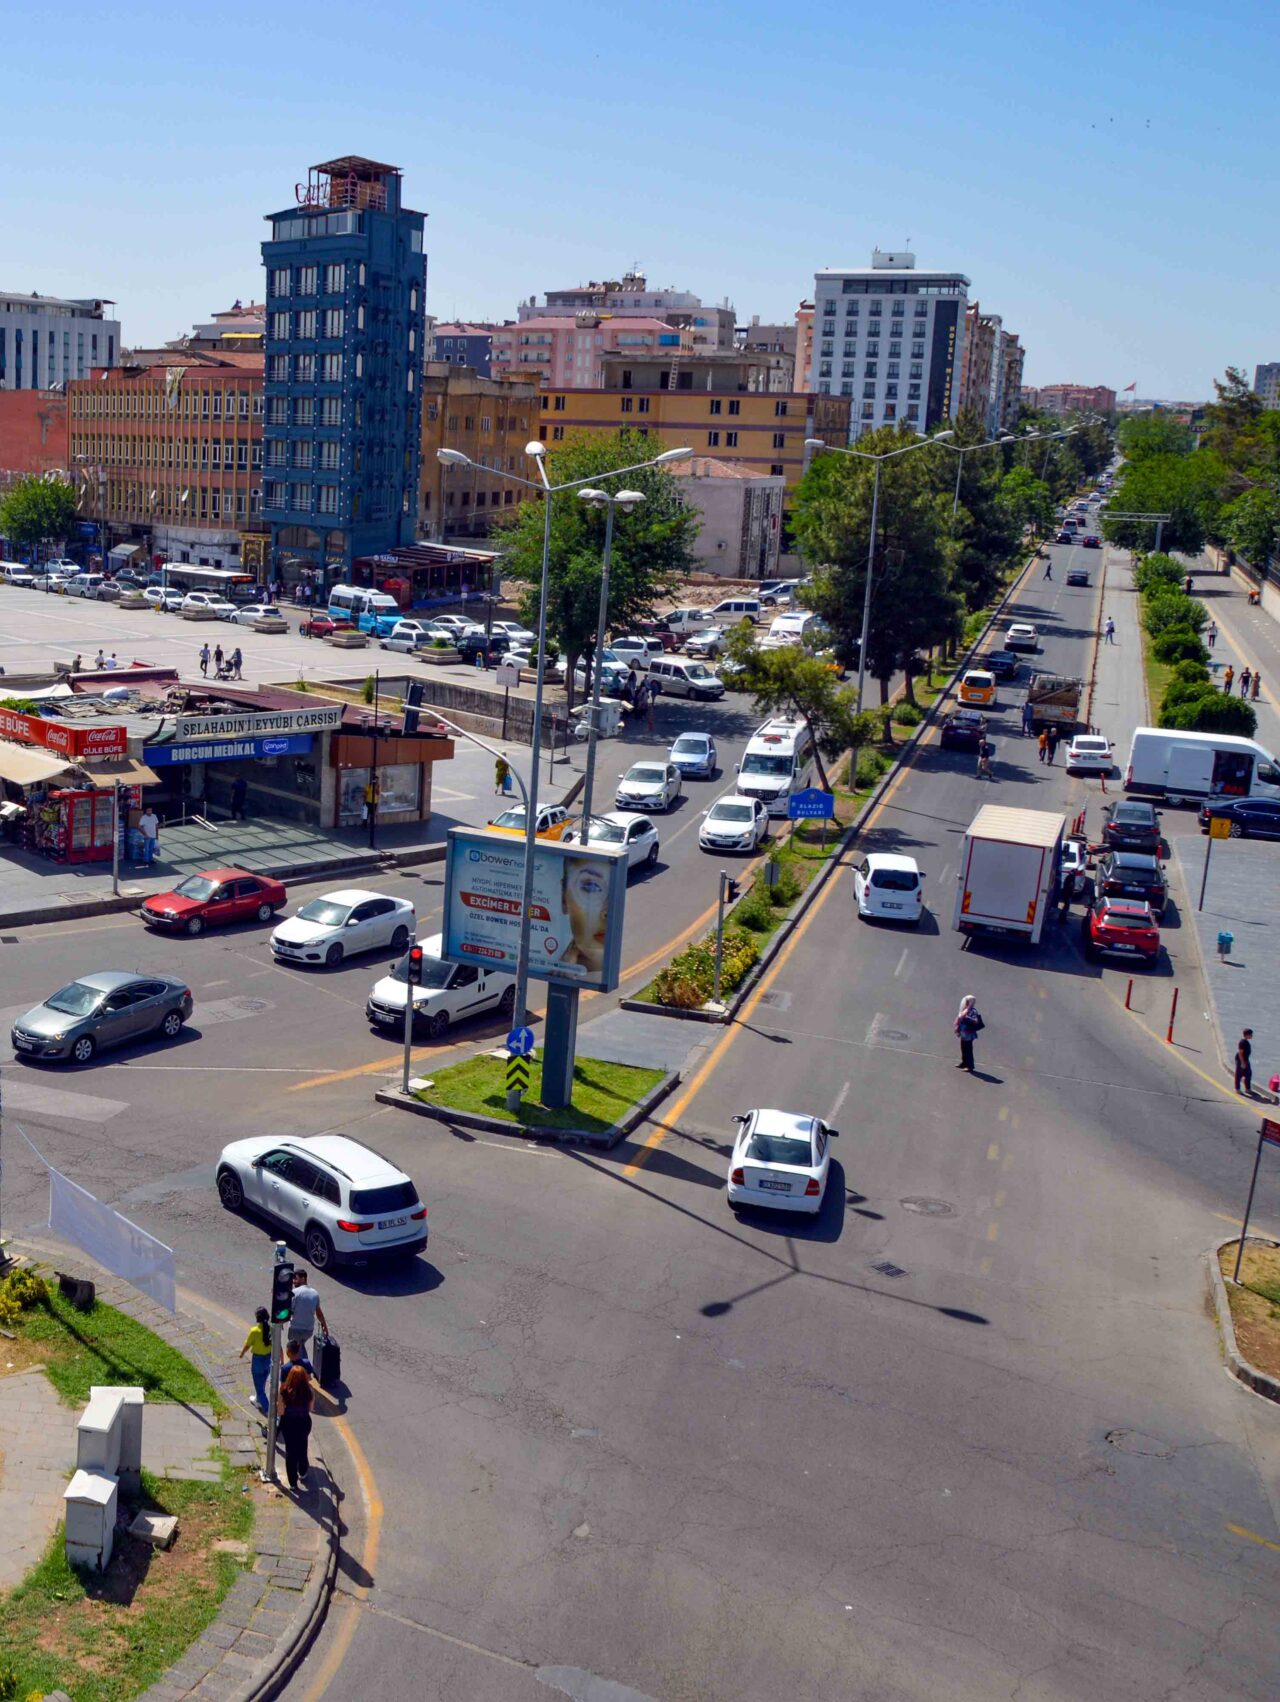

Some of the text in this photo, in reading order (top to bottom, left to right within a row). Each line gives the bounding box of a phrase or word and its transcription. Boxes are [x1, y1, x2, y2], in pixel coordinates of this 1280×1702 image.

[947, 326, 955, 360] HOTEL
[6, 713, 30, 736] BÜFE
[104, 745, 123, 754] BÜFE
[214, 741, 255, 757] MEDİKAL
[470, 896, 541, 917] EXCİMER LAER
